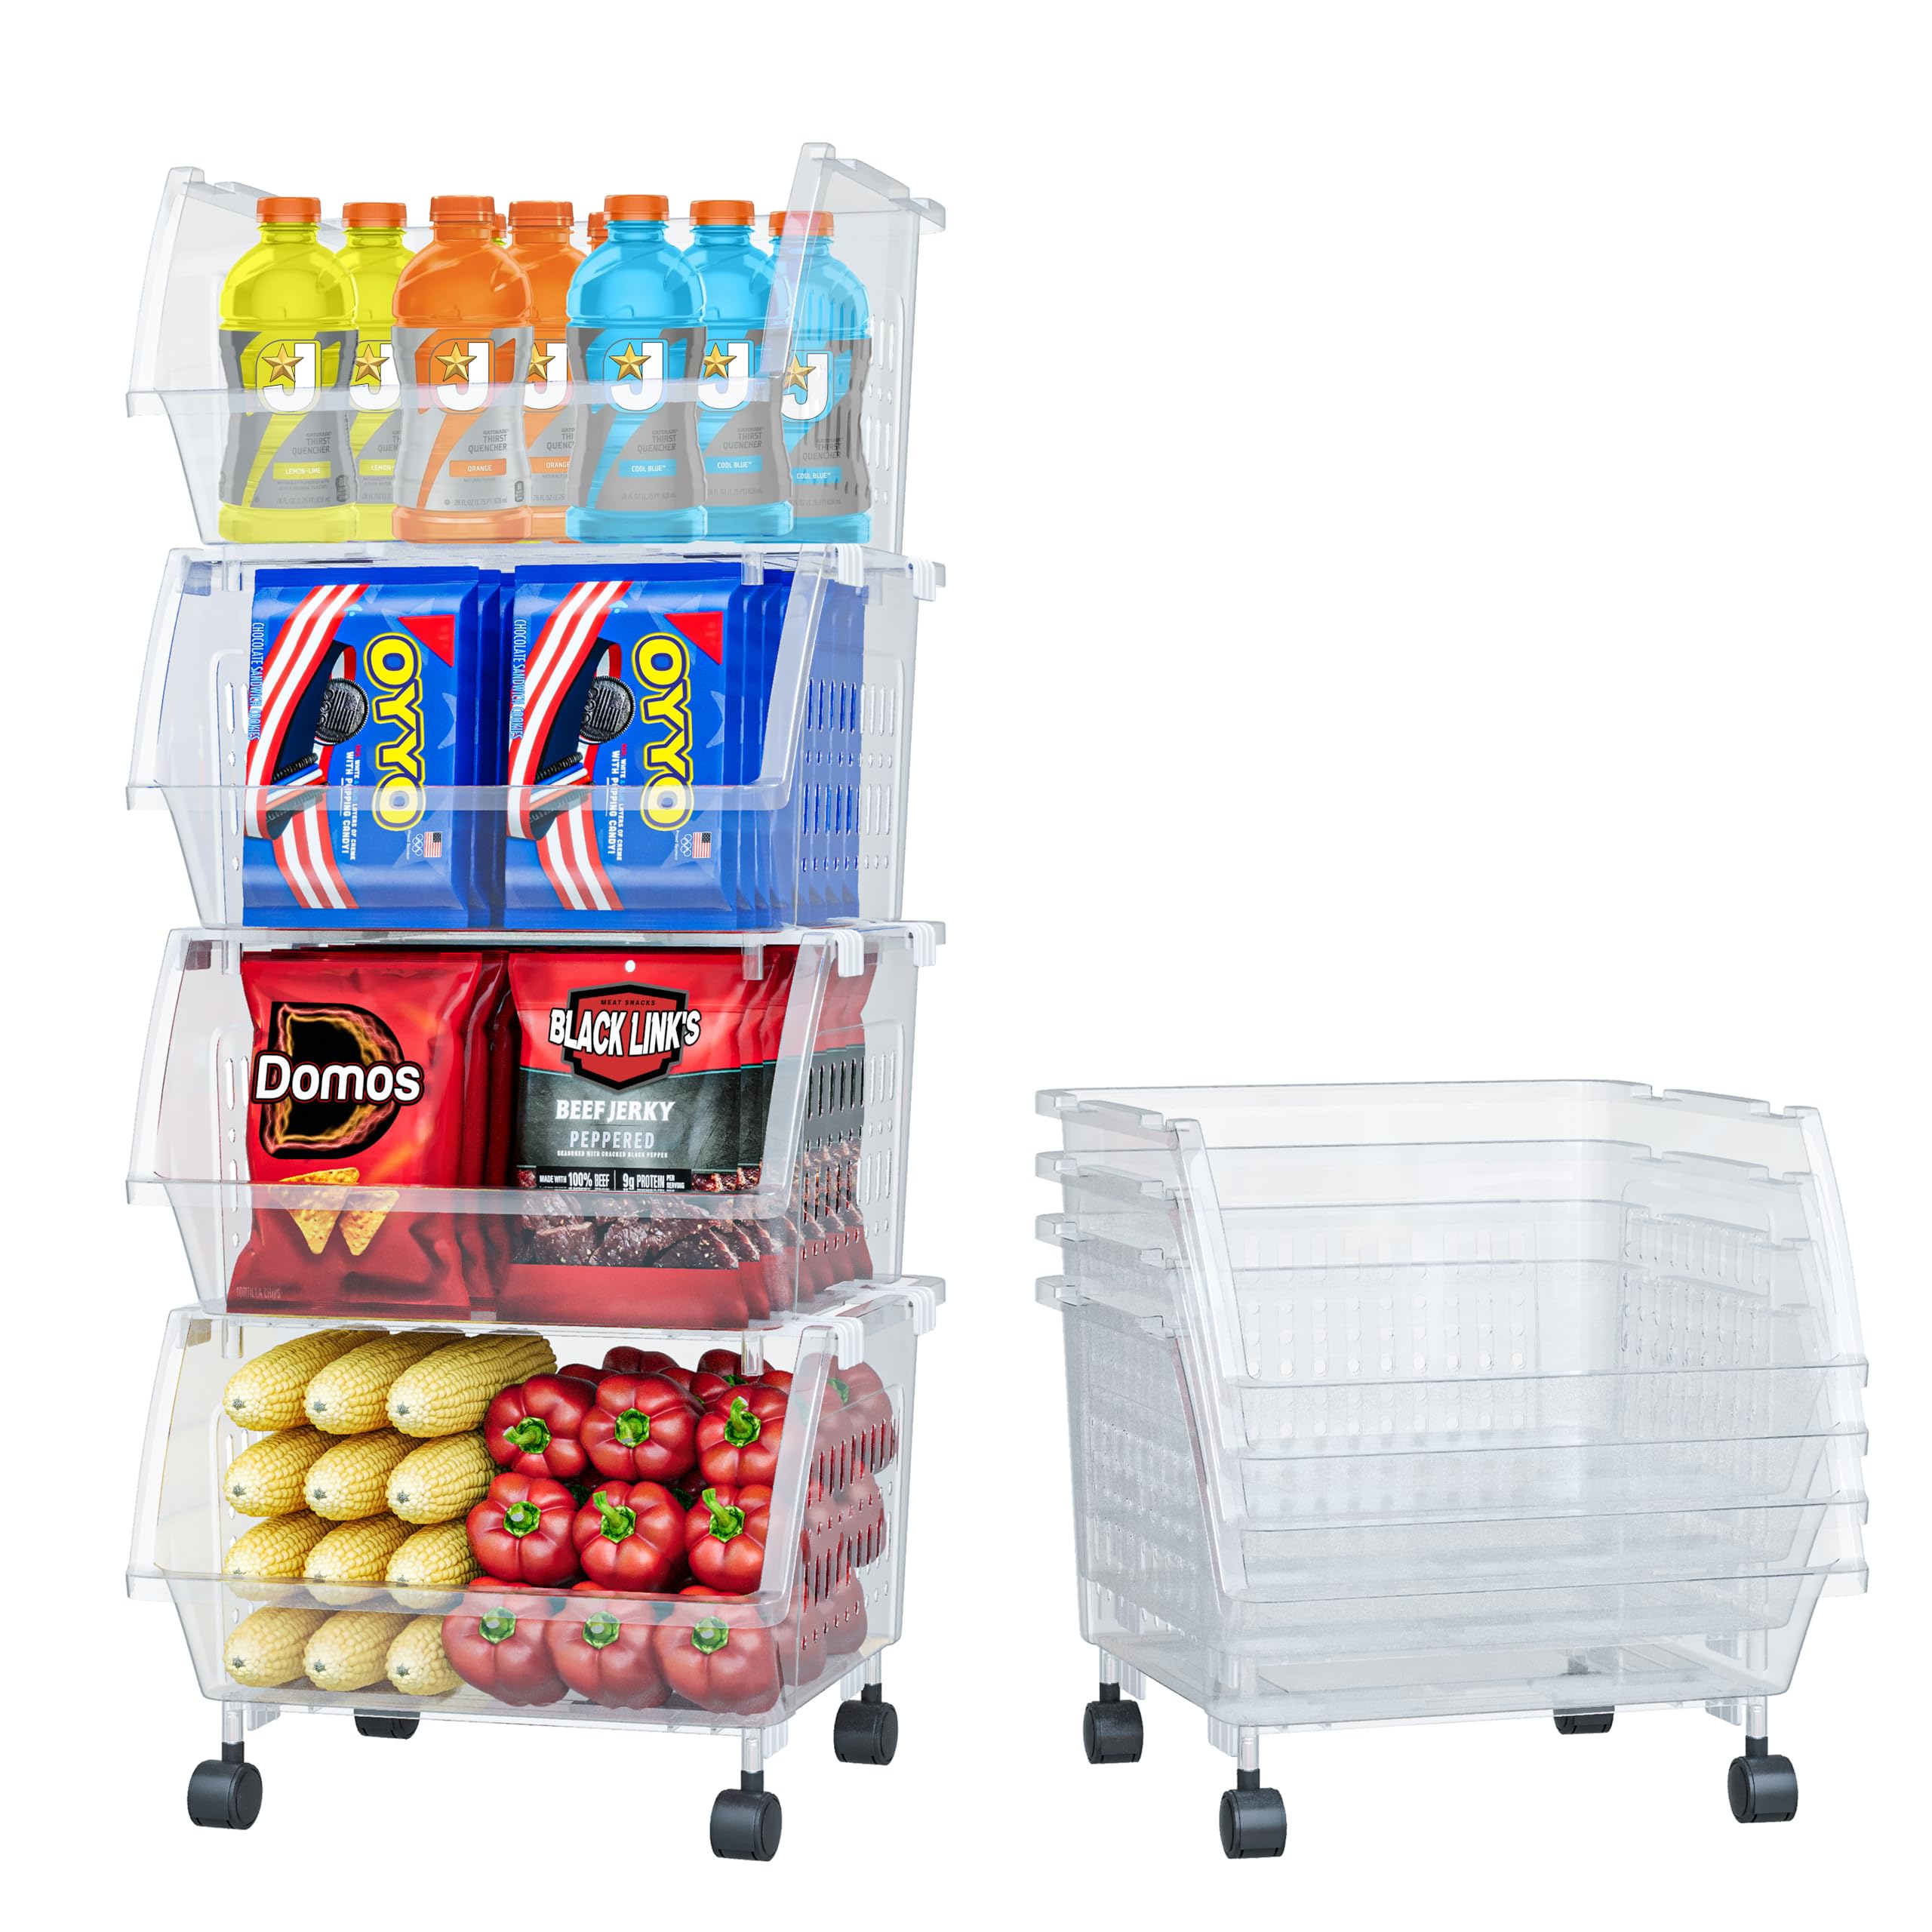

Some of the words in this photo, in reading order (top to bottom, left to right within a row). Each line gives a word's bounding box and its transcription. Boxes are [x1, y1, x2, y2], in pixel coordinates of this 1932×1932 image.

[306, 437, 331, 446] THIRST
[483, 435, 507, 443] THIRST
[651, 435, 676, 443] THIRST
[723, 440, 761, 451] QUENCHER
[738, 432, 762, 440] THIRST
[292, 445, 331, 457] QUENCHER
[468, 443, 507, 454] QUENCHER
[637, 443, 676, 454] QUENCHER
[802, 451, 841, 461] QUENCHER
[285, 467, 321, 475] LEMON-LIME
[251, 622, 265, 666] CHOCOLATE
[513, 619, 527, 663] CHOCOLATE
[249, 666, 263, 707] SANDWICH
[512, 663, 526, 705] SANDWICH
[248, 708, 262, 741] COOKIES
[364, 632, 426, 832] OYYO
[509, 706, 524, 740] COOKIES
[632, 632, 694, 831] OYYO
[345, 751, 354, 775] WITH
[611, 750, 620, 775] WITH
[341, 820, 351, 854] CANDY!
[351, 828, 357, 838] OF
[608, 820, 617, 854] CANDY!
[617, 829, 623, 838] OF
[549, 1008, 628, 1056] BLACK
[628, 1008, 702, 1056] LINK'S
[254, 1053, 423, 1103] Domos
[555, 1100, 606, 1120] BEEF
[606, 1100, 676, 1124] JERKY
[570, 1131, 655, 1149] PEPPERED
[539, 1175, 554, 1183] MADE
[554, 1175, 567, 1183] WITH
[568, 1172, 592, 1187] 100%
[594, 1174, 610, 1187] BEEF
[623, 1173, 635, 1190] 9g
[636, 1174, 665, 1189] PROTEIN
